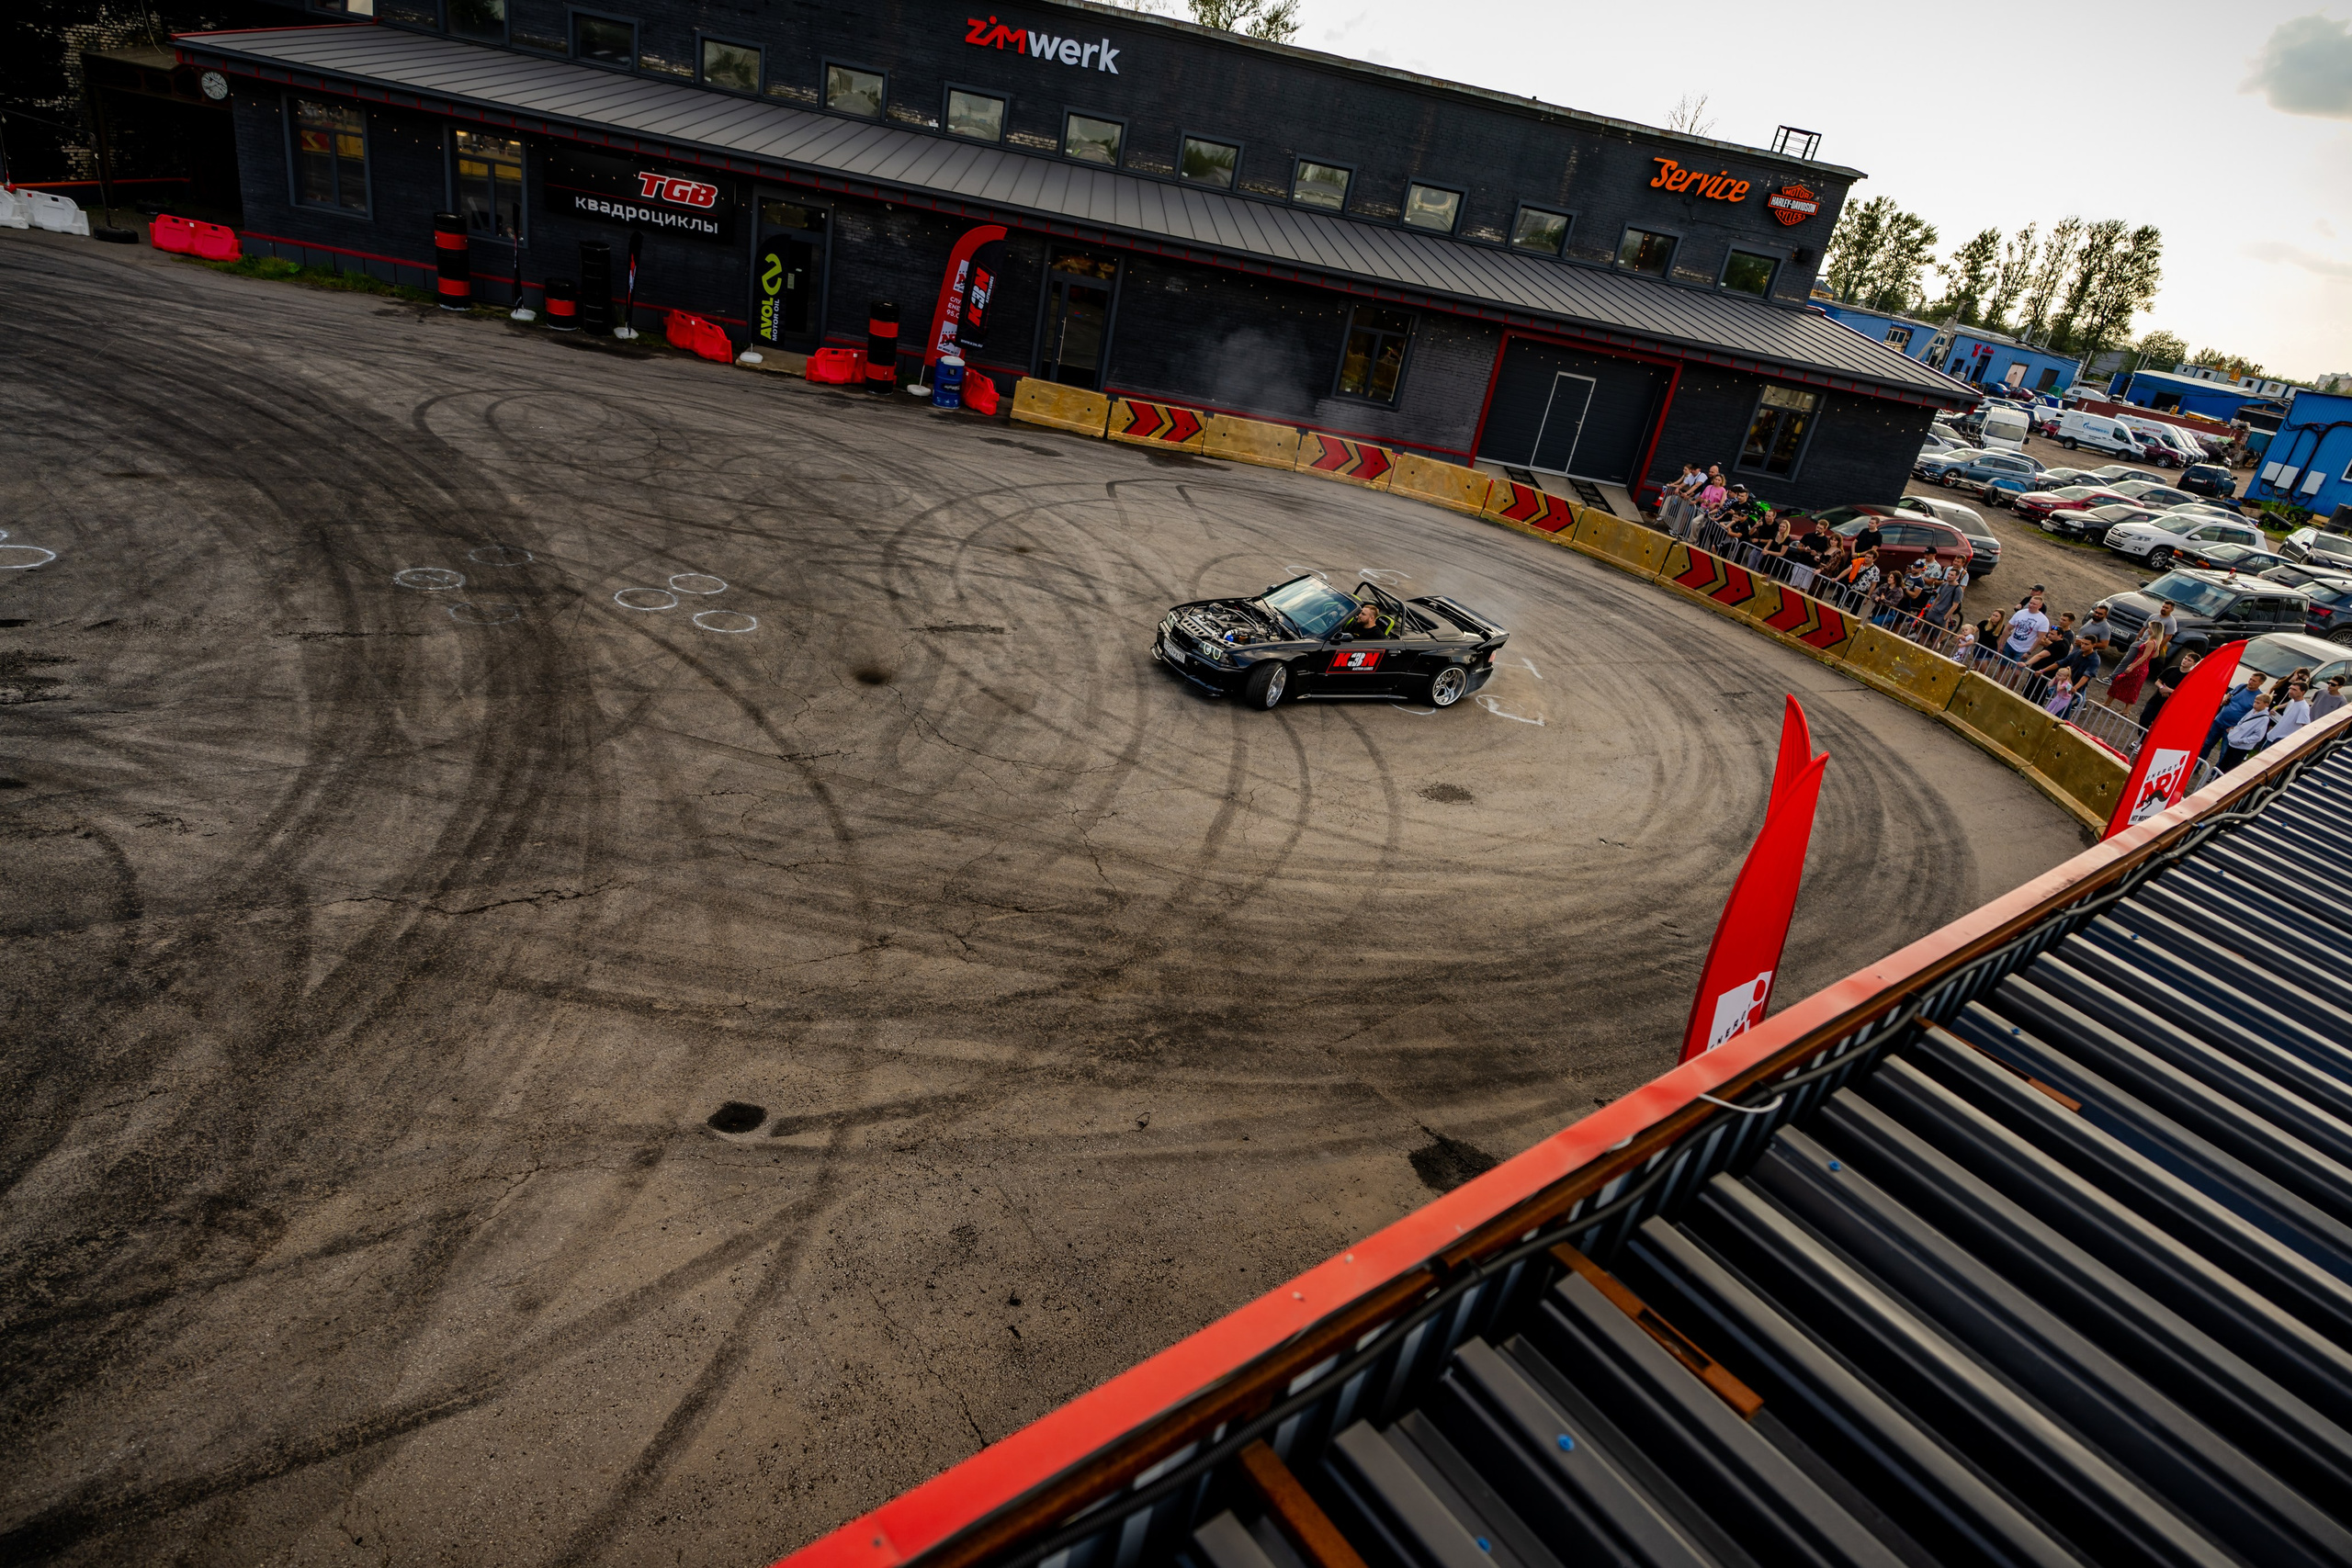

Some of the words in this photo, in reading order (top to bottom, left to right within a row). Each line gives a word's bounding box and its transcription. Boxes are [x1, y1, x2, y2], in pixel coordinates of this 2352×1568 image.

[1650, 157, 1750, 203] Service
[638, 172, 718, 209] TGB
[1785, 187, 1810, 199] MOTOR
[1770, 196, 1817, 214] HARLEY-DAVIDSON
[575, 196, 718, 234] квадроциклы
[1778, 209, 1803, 223] CYCLES
[947, 302, 961, 311] ENE
[950, 296, 962, 305] СЛУ
[761, 298, 774, 340] AVOL
[1333, 652, 1380, 667] K3N
[2146, 763, 2178, 781] ENERGY
